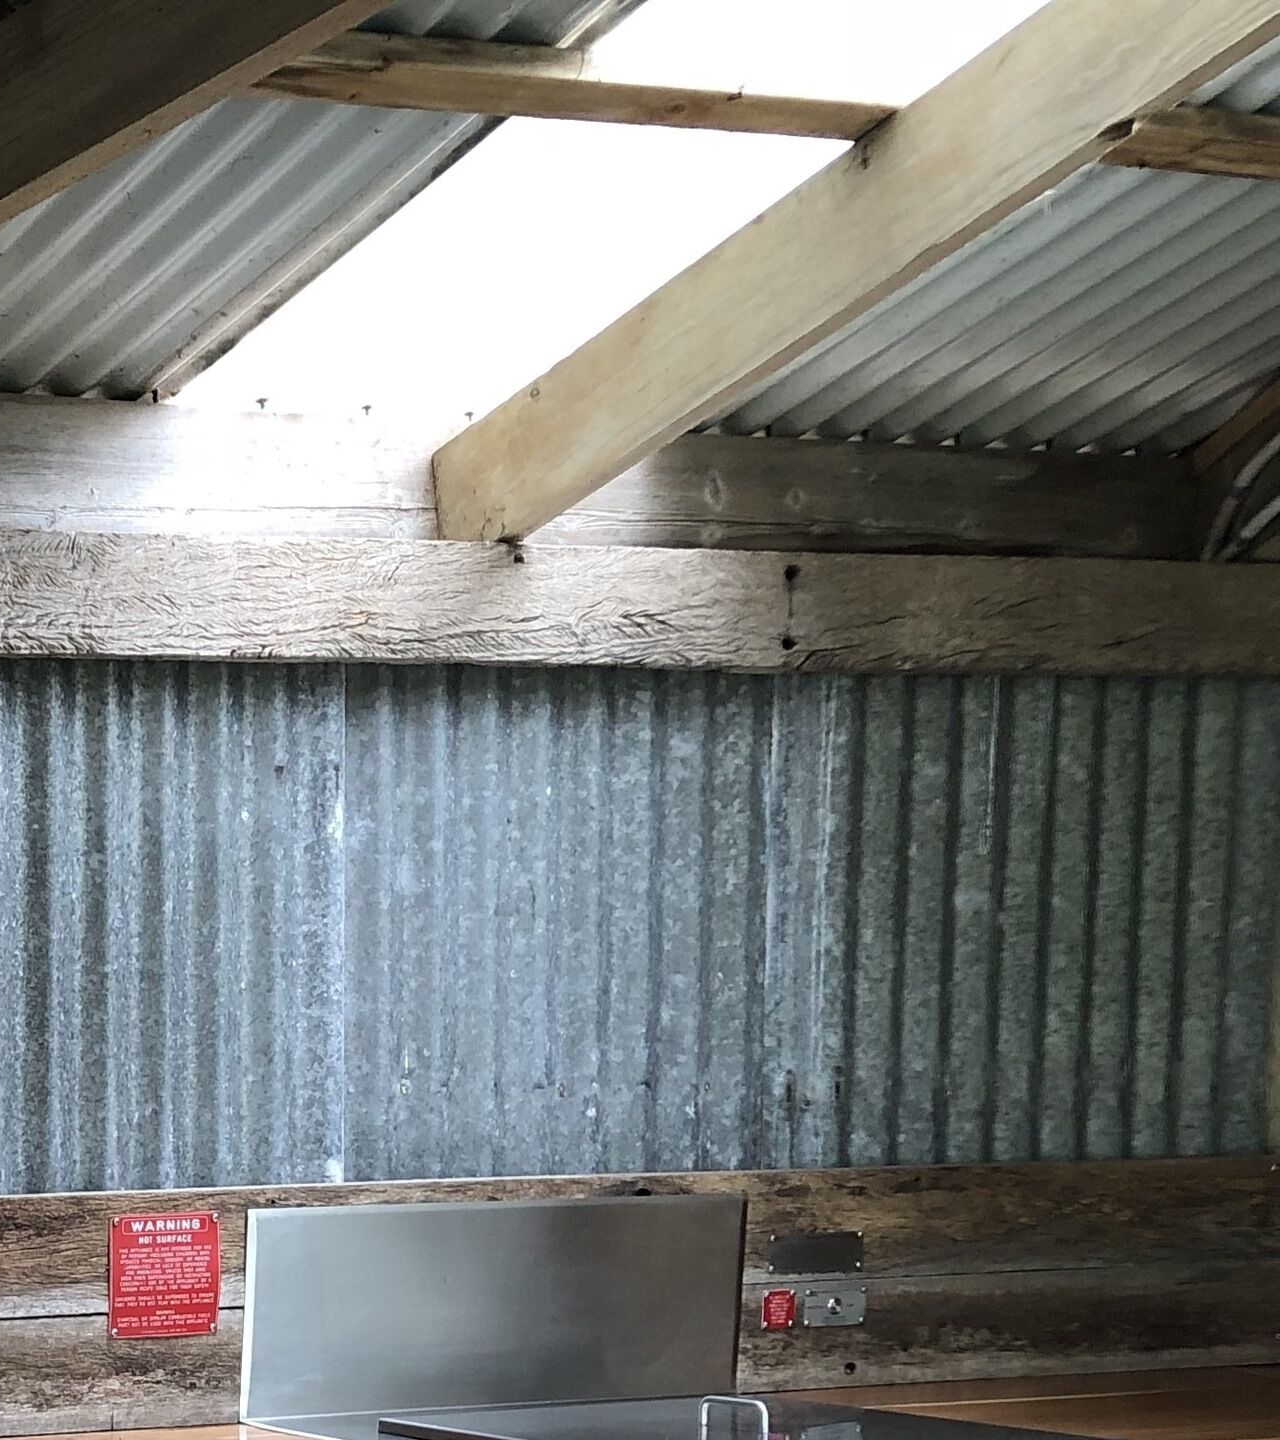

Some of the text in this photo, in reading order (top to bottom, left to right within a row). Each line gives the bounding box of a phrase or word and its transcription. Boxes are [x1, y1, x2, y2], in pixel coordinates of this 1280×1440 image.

[131, 1219, 201, 1232] WARNING
[139, 1234, 192, 1245] HOT SURFACE
